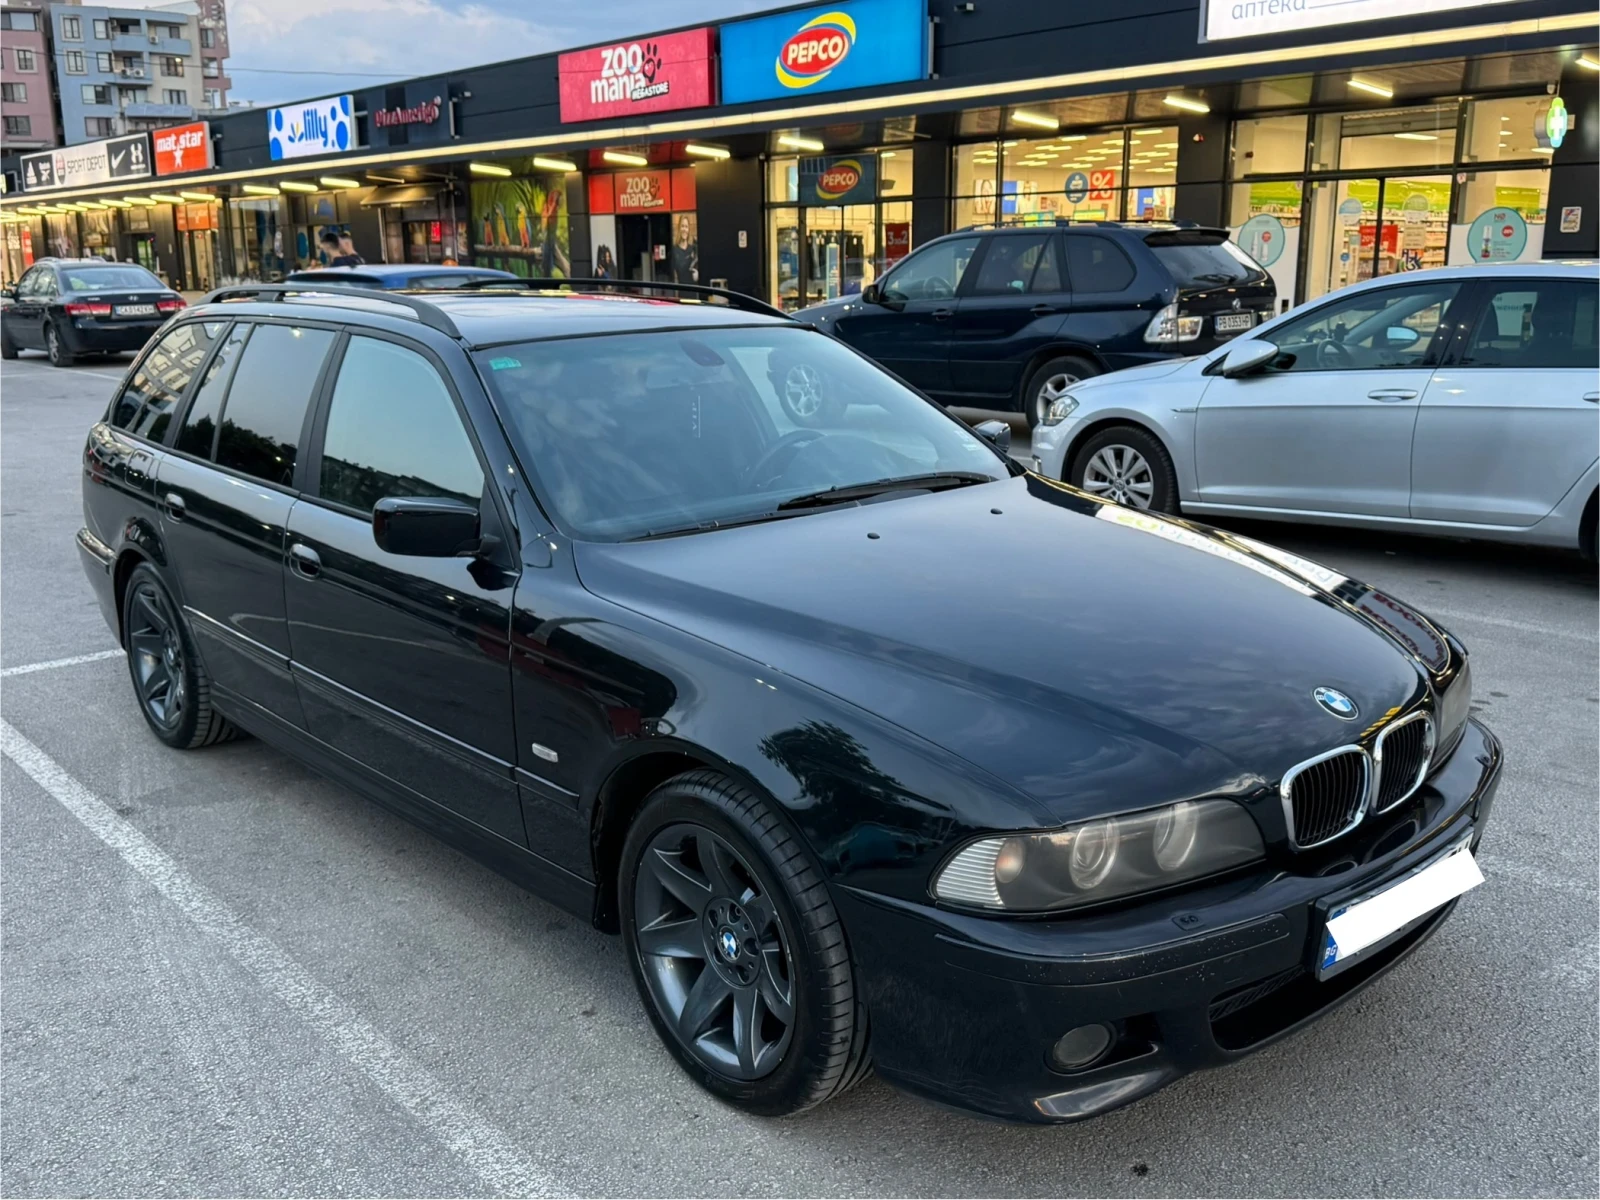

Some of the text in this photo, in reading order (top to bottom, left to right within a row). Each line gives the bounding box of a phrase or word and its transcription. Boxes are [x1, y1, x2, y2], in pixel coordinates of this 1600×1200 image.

[1232, 0, 1306, 20] аптека
[787, 35, 844, 66] PEPCO
[590, 73, 646, 104] mania
[303, 108, 328, 148] lilly
[156, 130, 203, 153] mat star
[67, 157, 86, 174] SPORT
[87, 154, 106, 171] DEPOT
[822, 173, 855, 187] PEPCO
[620, 191, 652, 208] mania
